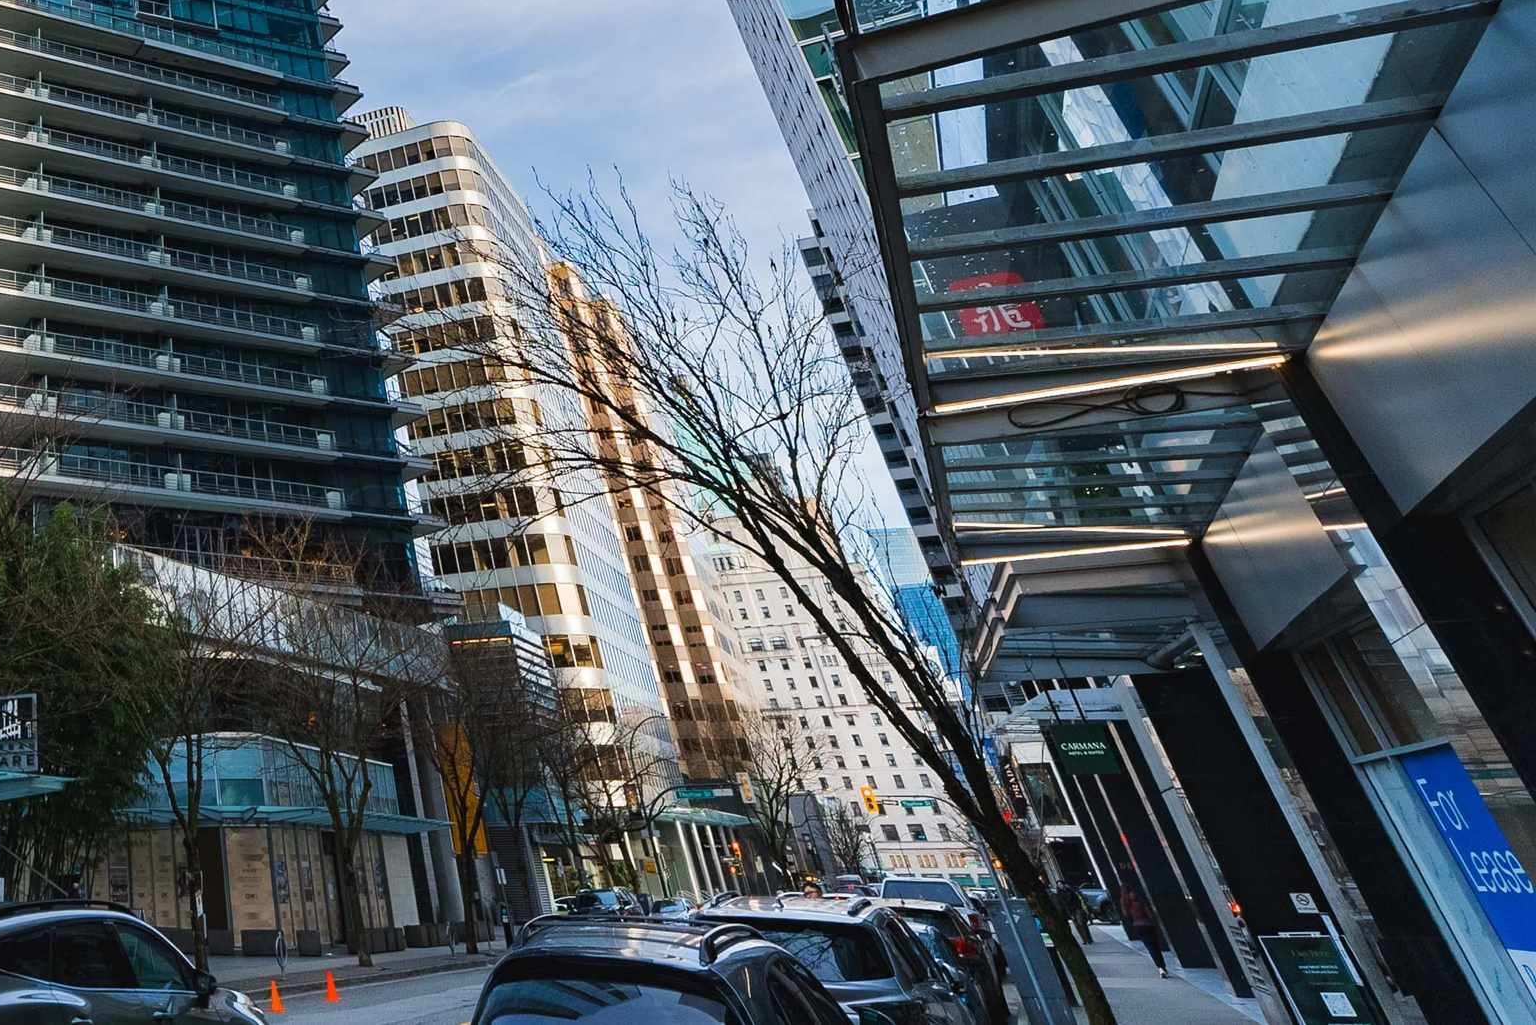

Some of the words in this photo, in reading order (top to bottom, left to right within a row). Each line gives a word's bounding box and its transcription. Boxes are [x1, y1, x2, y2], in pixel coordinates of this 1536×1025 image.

[1061, 742, 1106, 750] CARMANA
[1004, 764, 1023, 798] PRADA
[1416, 778, 1469, 831] For
[1449, 838, 1534, 893] Lease
